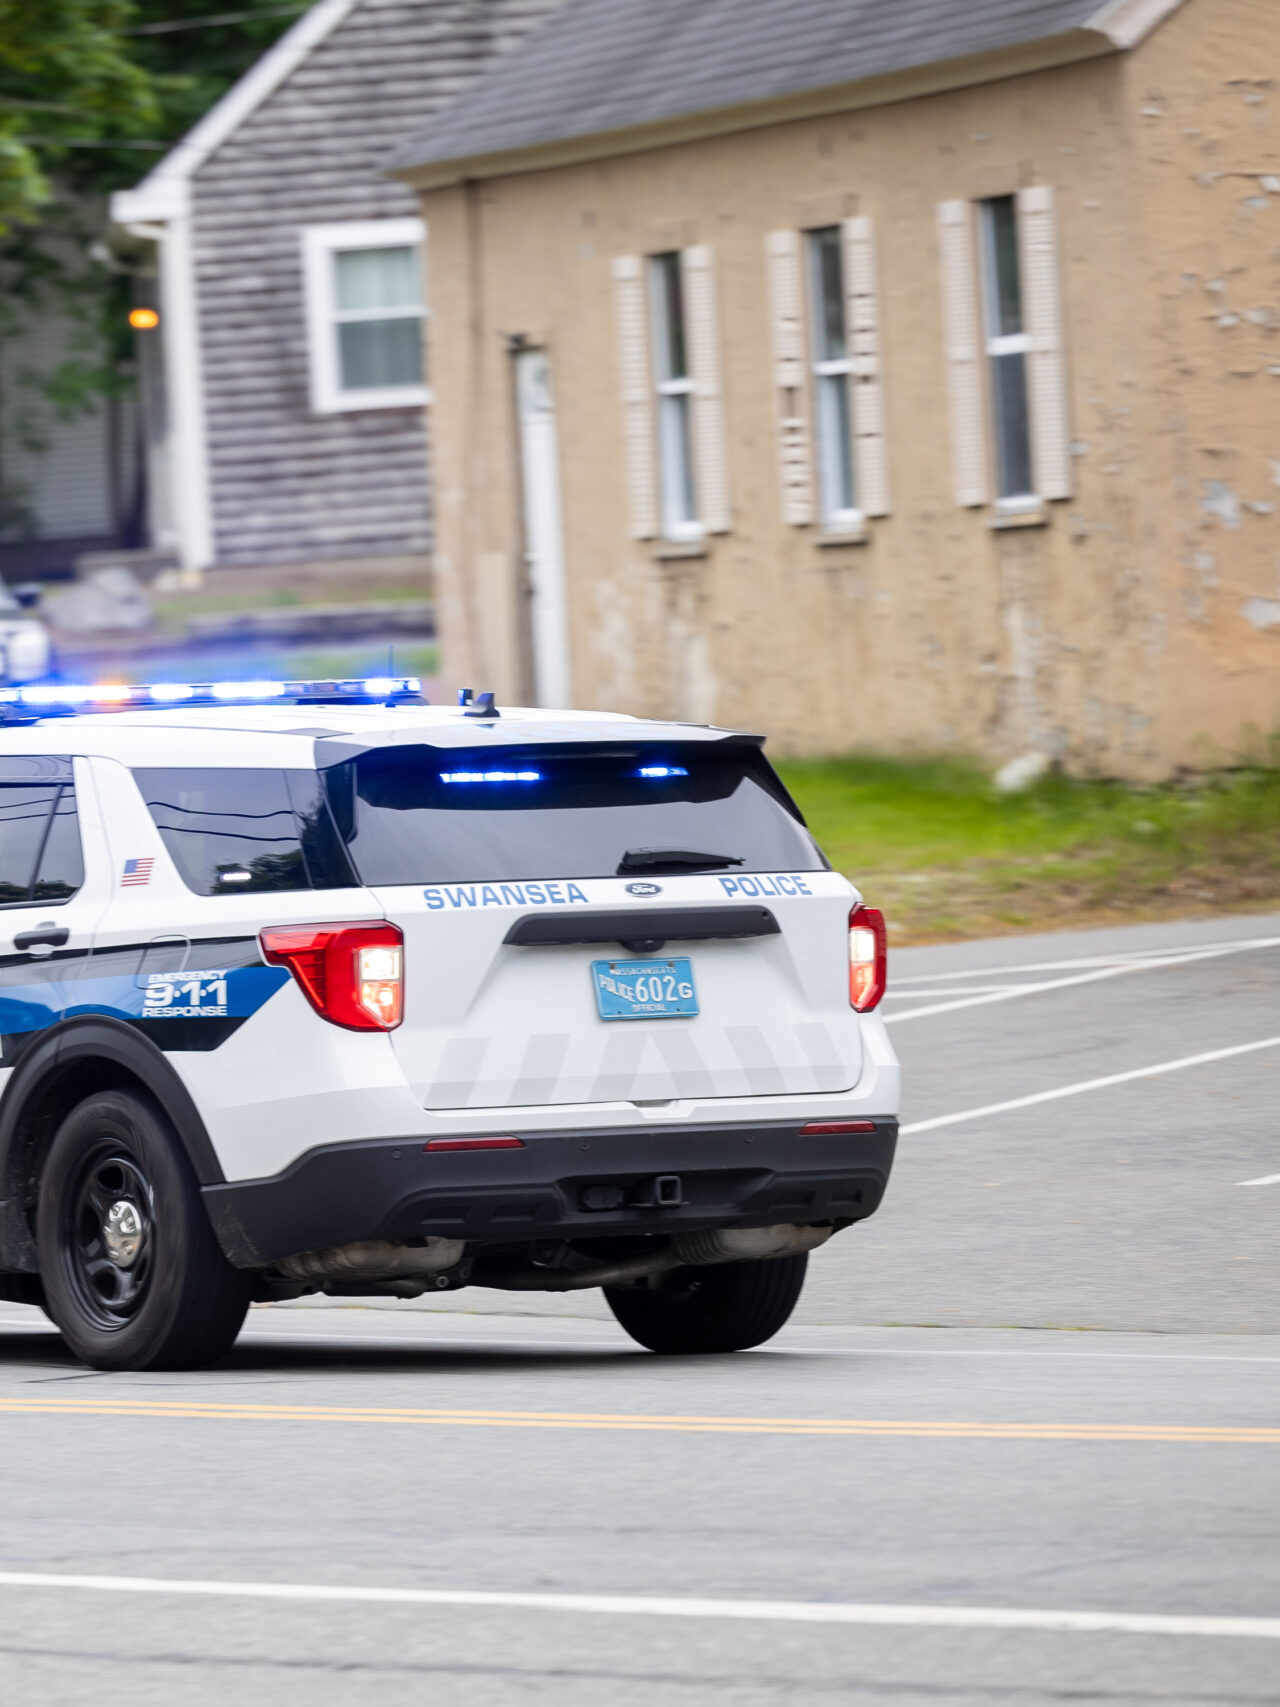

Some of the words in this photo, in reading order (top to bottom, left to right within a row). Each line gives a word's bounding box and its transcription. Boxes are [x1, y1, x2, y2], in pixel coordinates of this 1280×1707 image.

[719, 876, 812, 897] POLICE
[424, 883, 589, 910] SWANSEA
[148, 970, 228, 983] EMERGENCY
[142, 1006, 228, 1017] RESPONSE
